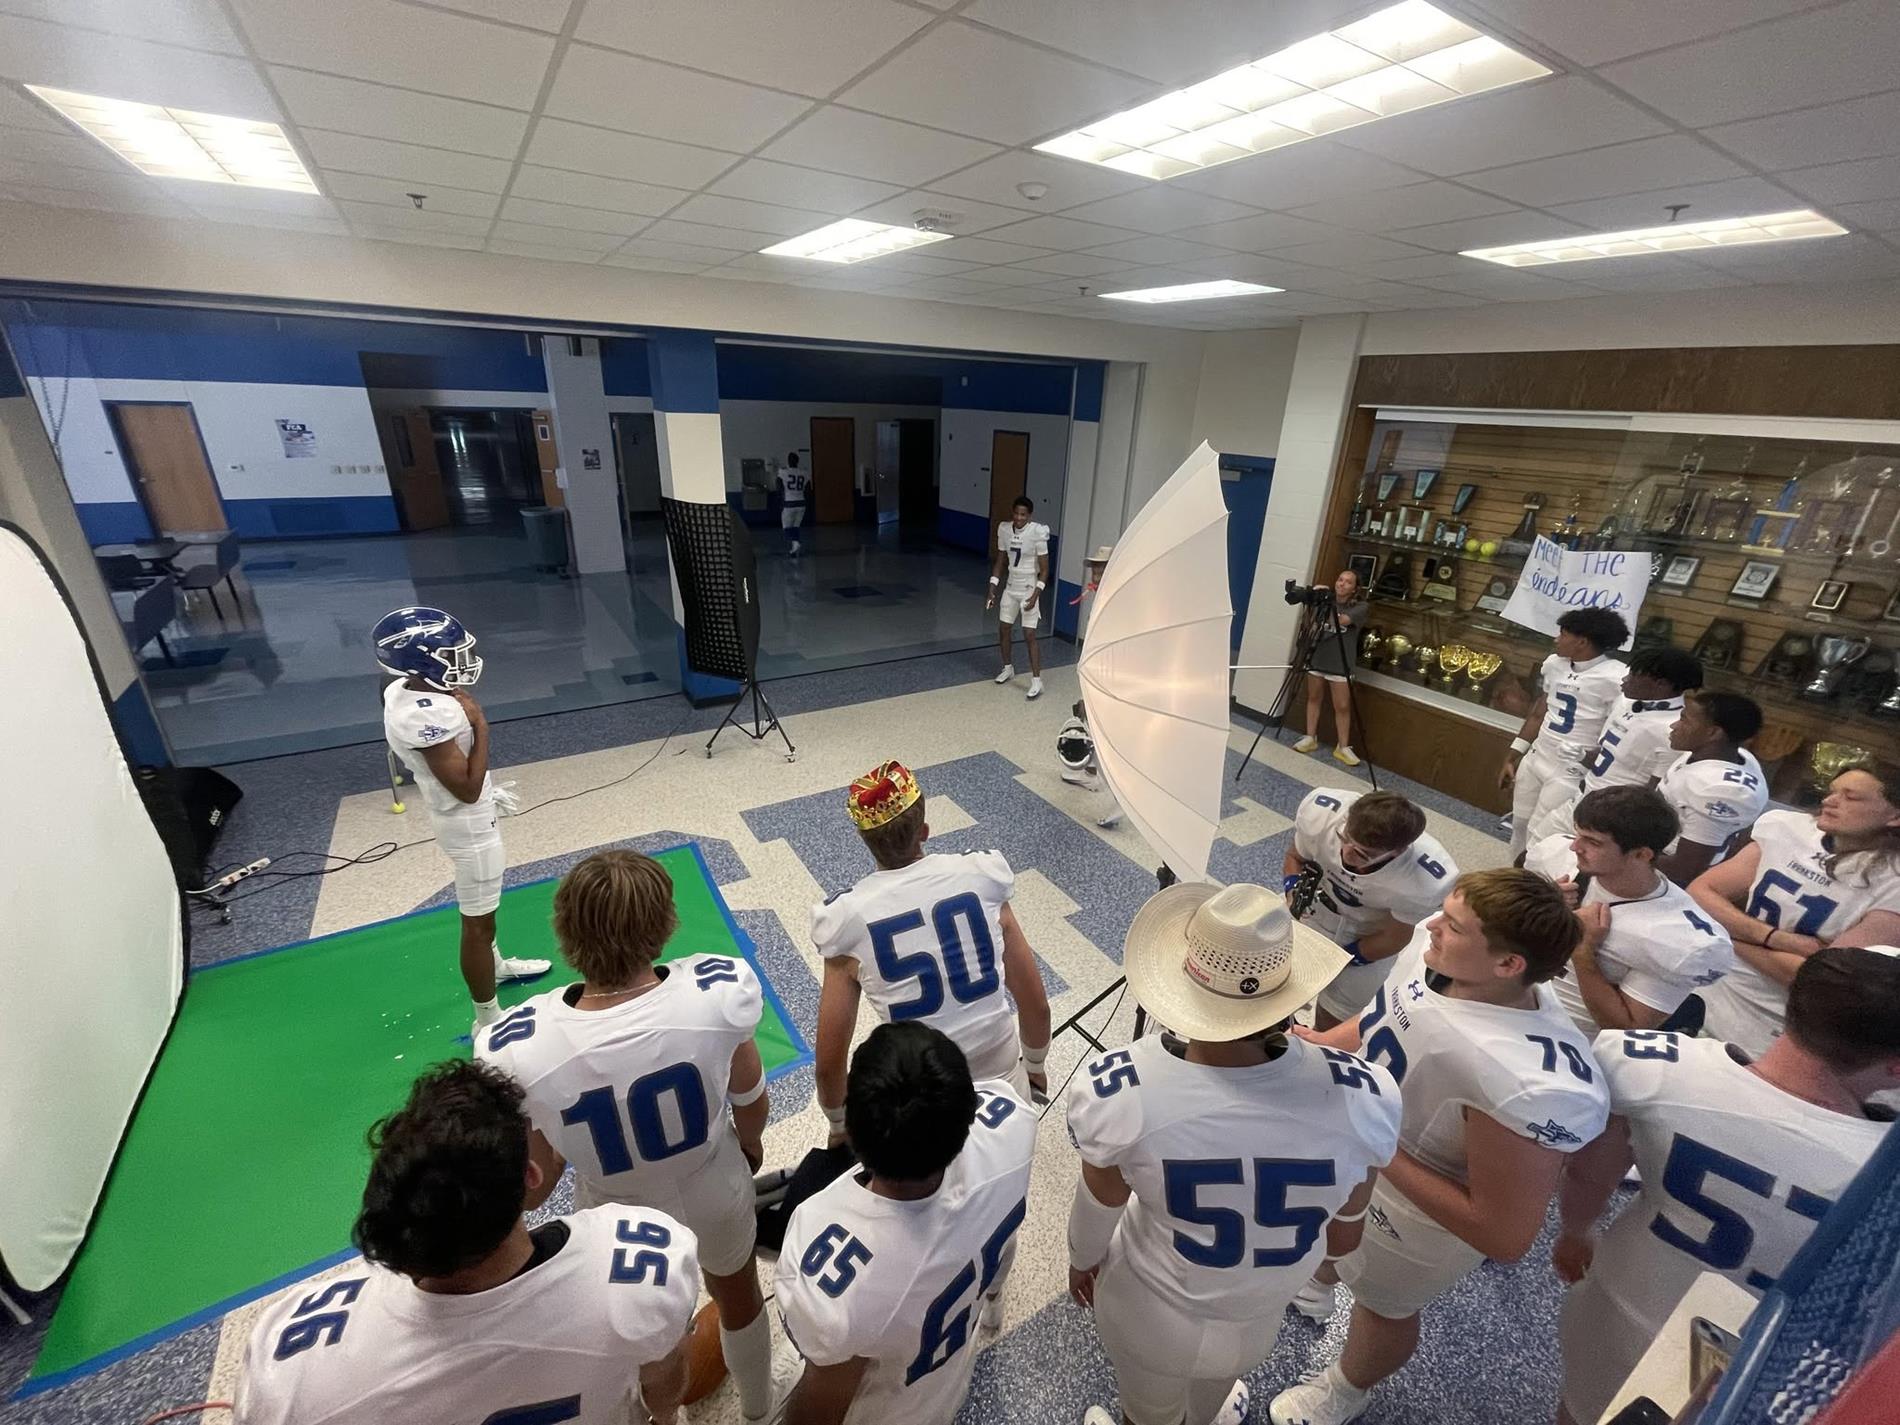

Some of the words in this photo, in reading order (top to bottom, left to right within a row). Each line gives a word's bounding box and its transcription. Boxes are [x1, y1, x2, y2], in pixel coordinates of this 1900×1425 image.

[787, 474, 805, 490] 28
[1010, 547, 1021, 567] 7
[1549, 692, 1577, 734] 3
[1314, 795, 1341, 812] 6
[1723, 767, 1759, 792] 22
[1417, 852, 1447, 879] 6
[1747, 868, 1840, 936] 61
[694, 958, 738, 991] 10
[866, 891, 1000, 1023] 50
[488, 1007, 536, 1052] 10
[1624, 1030, 1679, 1063] 53
[1088, 1050, 1141, 1099] 55
[1322, 1047, 1381, 1096] 55
[1525, 1034, 1593, 1084] 70
[560, 1061, 709, 1177] 10
[1162, 1157, 1336, 1268] 55
[609, 1219, 671, 1287] 56
[801, 1223, 874, 1299] 65
[273, 1277, 370, 1362] 56
